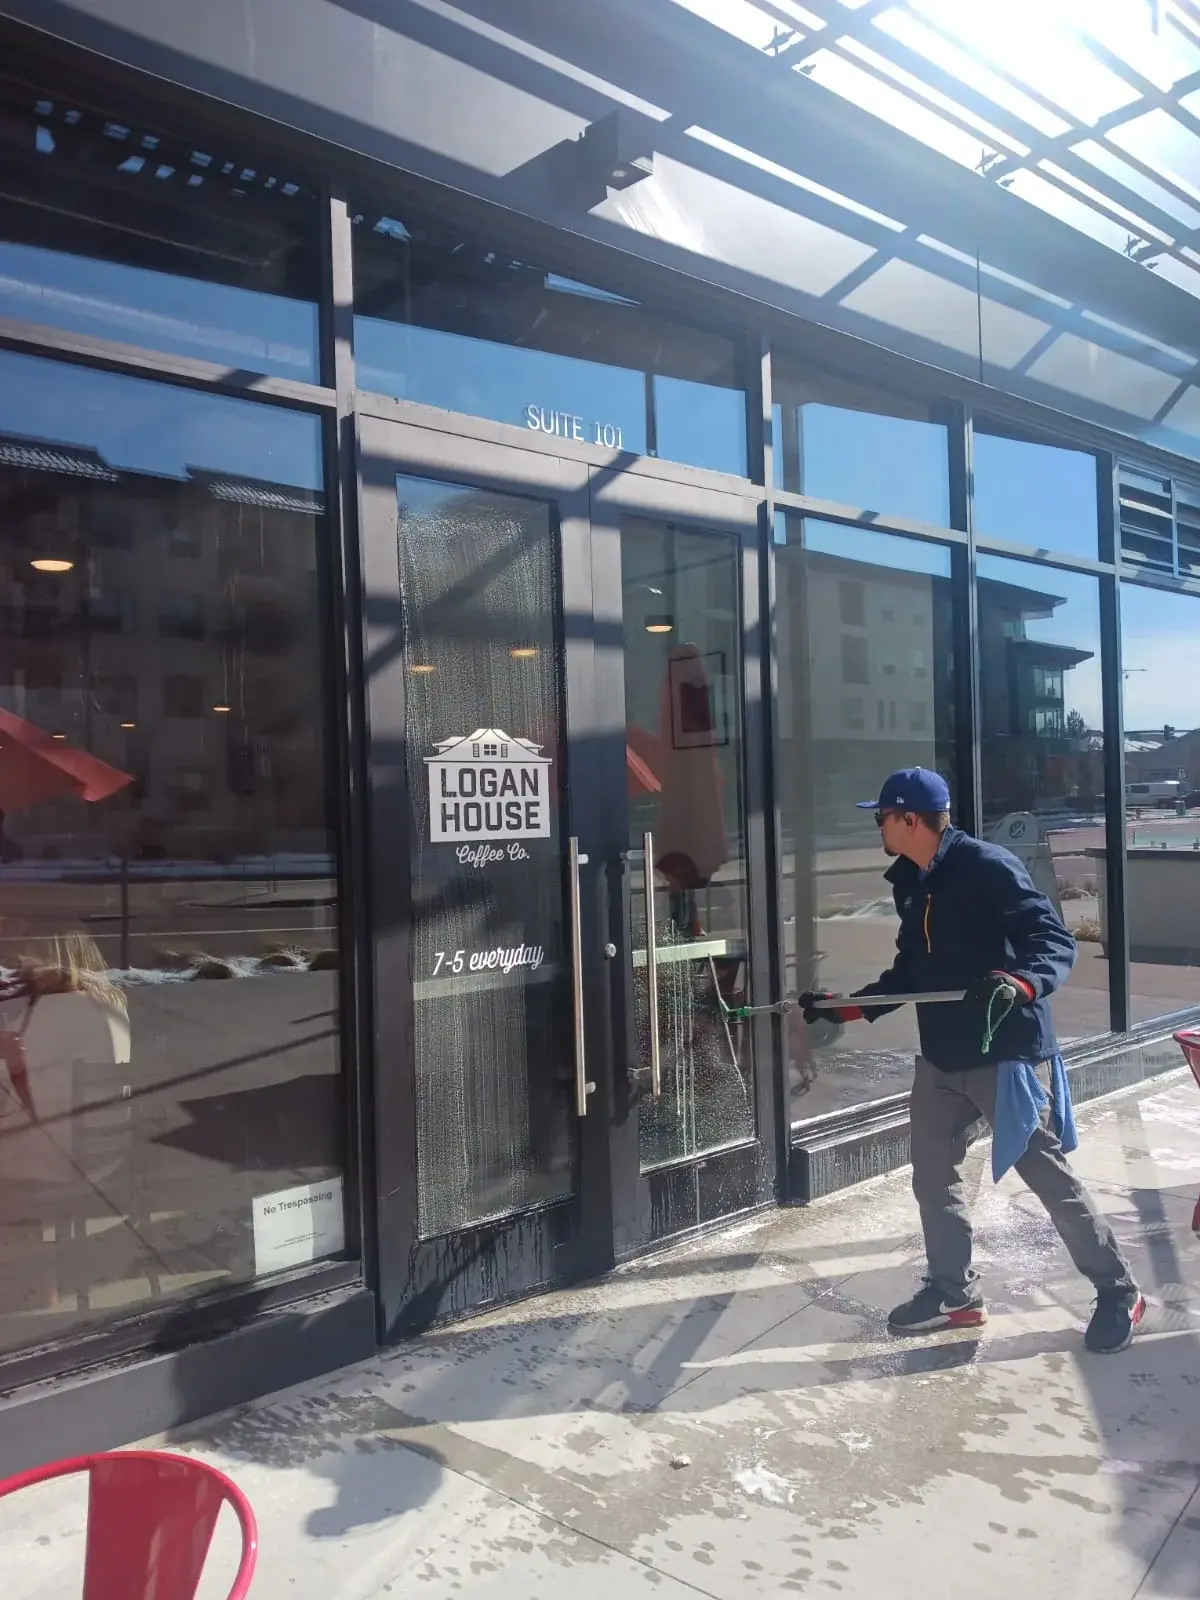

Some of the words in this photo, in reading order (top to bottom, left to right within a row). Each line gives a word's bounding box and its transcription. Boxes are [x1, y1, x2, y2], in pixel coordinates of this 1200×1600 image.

[526, 404, 585, 441] SUITE
[594, 421, 625, 450] 101
[441, 768, 539, 797] LOGAN
[440, 801, 541, 833] HOUSE
[456, 845, 504, 868] Coffee
[507, 842, 530, 861] Co.
[432, 951, 465, 976] 7-5
[469, 943, 544, 974] everyday
[263, 1205, 276, 1216] No
[278, 1191, 333, 1212] Trespassing
